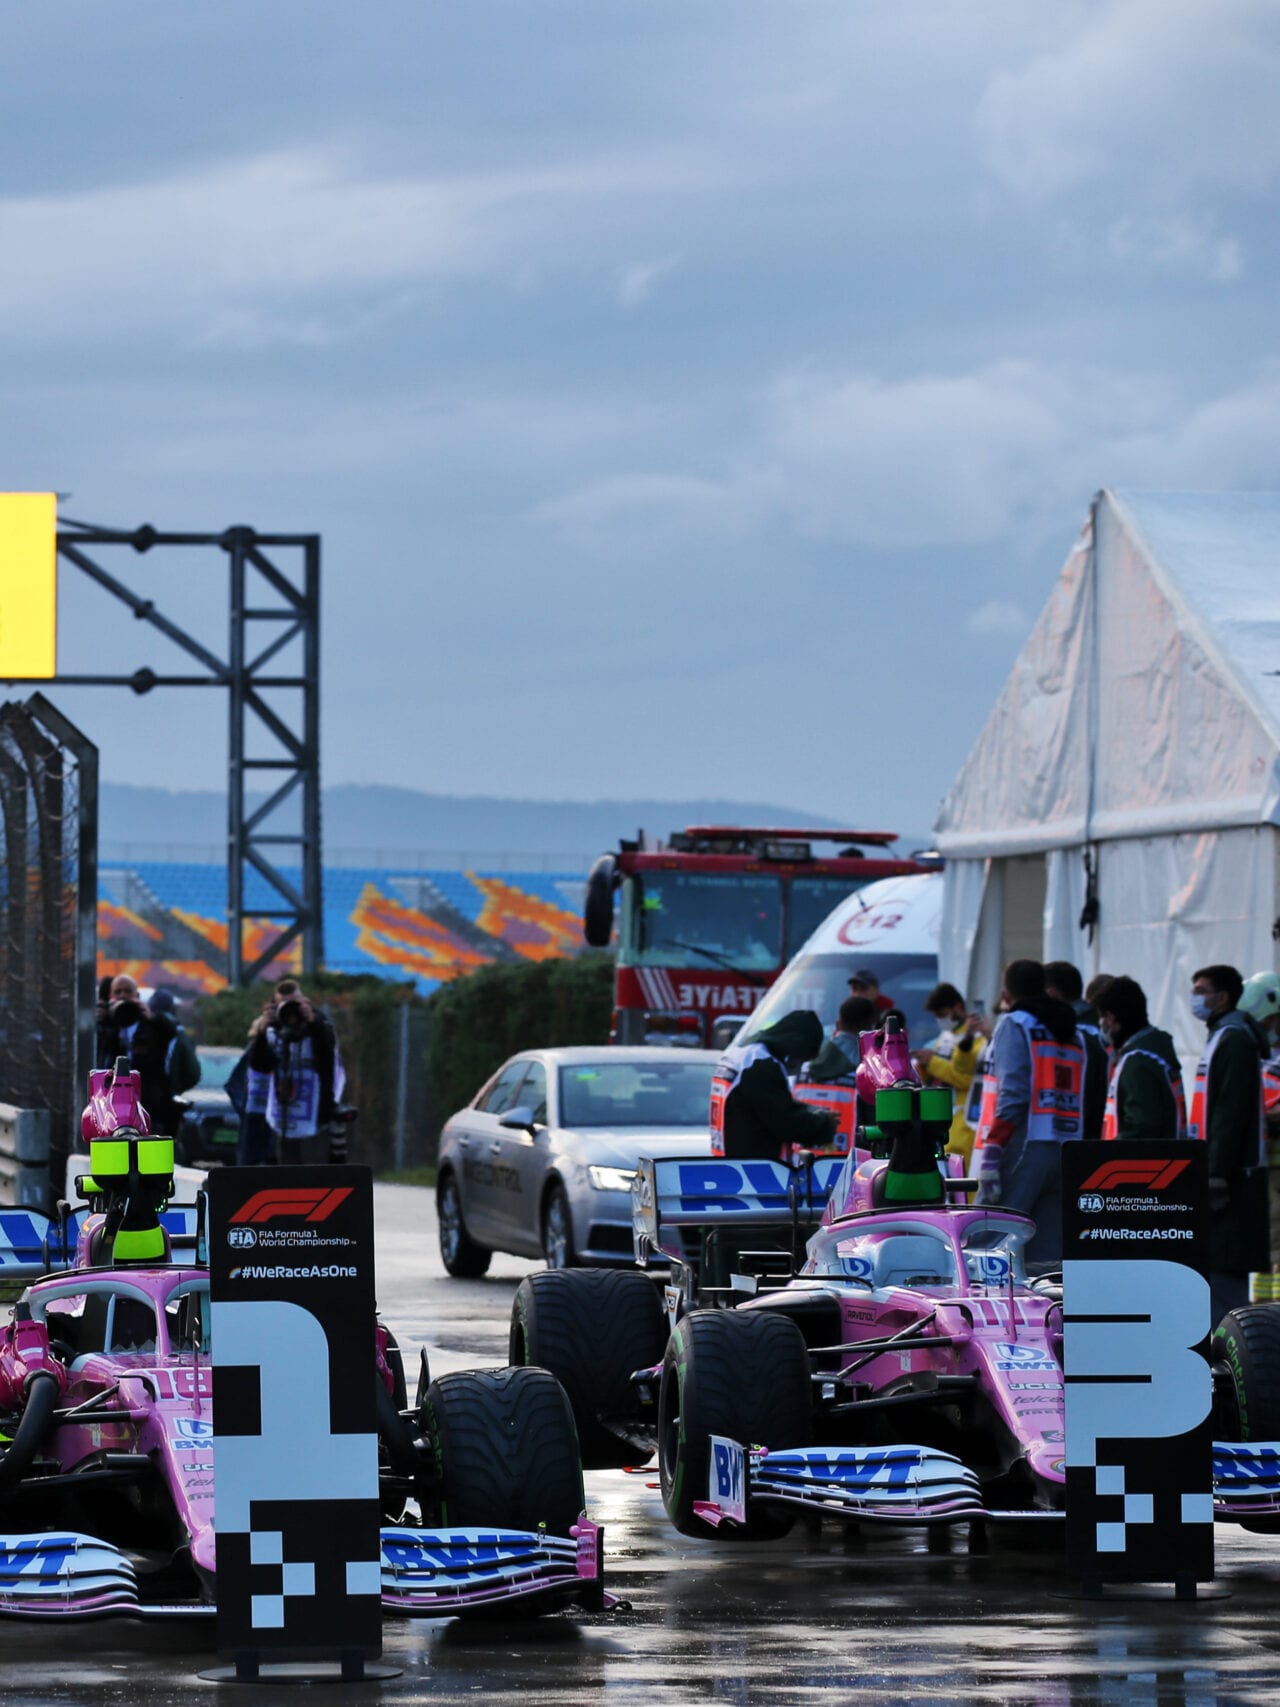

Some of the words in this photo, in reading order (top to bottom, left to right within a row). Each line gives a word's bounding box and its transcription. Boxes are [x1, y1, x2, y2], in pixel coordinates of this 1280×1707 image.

[676, 1163, 844, 1212] BW
[1131, 1203, 1188, 1212] Championship
[259, 1231, 274, 1239] FIA
[275, 1230, 312, 1239] Formula
[1090, 1228, 1194, 1240] #WeRaceAsOne
[259, 1238, 286, 1247] World
[287, 1237, 350, 1247] Championship
[241, 1265, 358, 1279] #WeRaceAsOne
[1062, 1260, 1212, 1438] 3
[996, 1362, 1057, 1370] BWT
[152, 1368, 212, 1399] 18
[211, 1301, 379, 1500] 1
[174, 1441, 213, 1449] BW
[756, 1450, 921, 1494] BWT
[1212, 1446, 1280, 1489] BW
